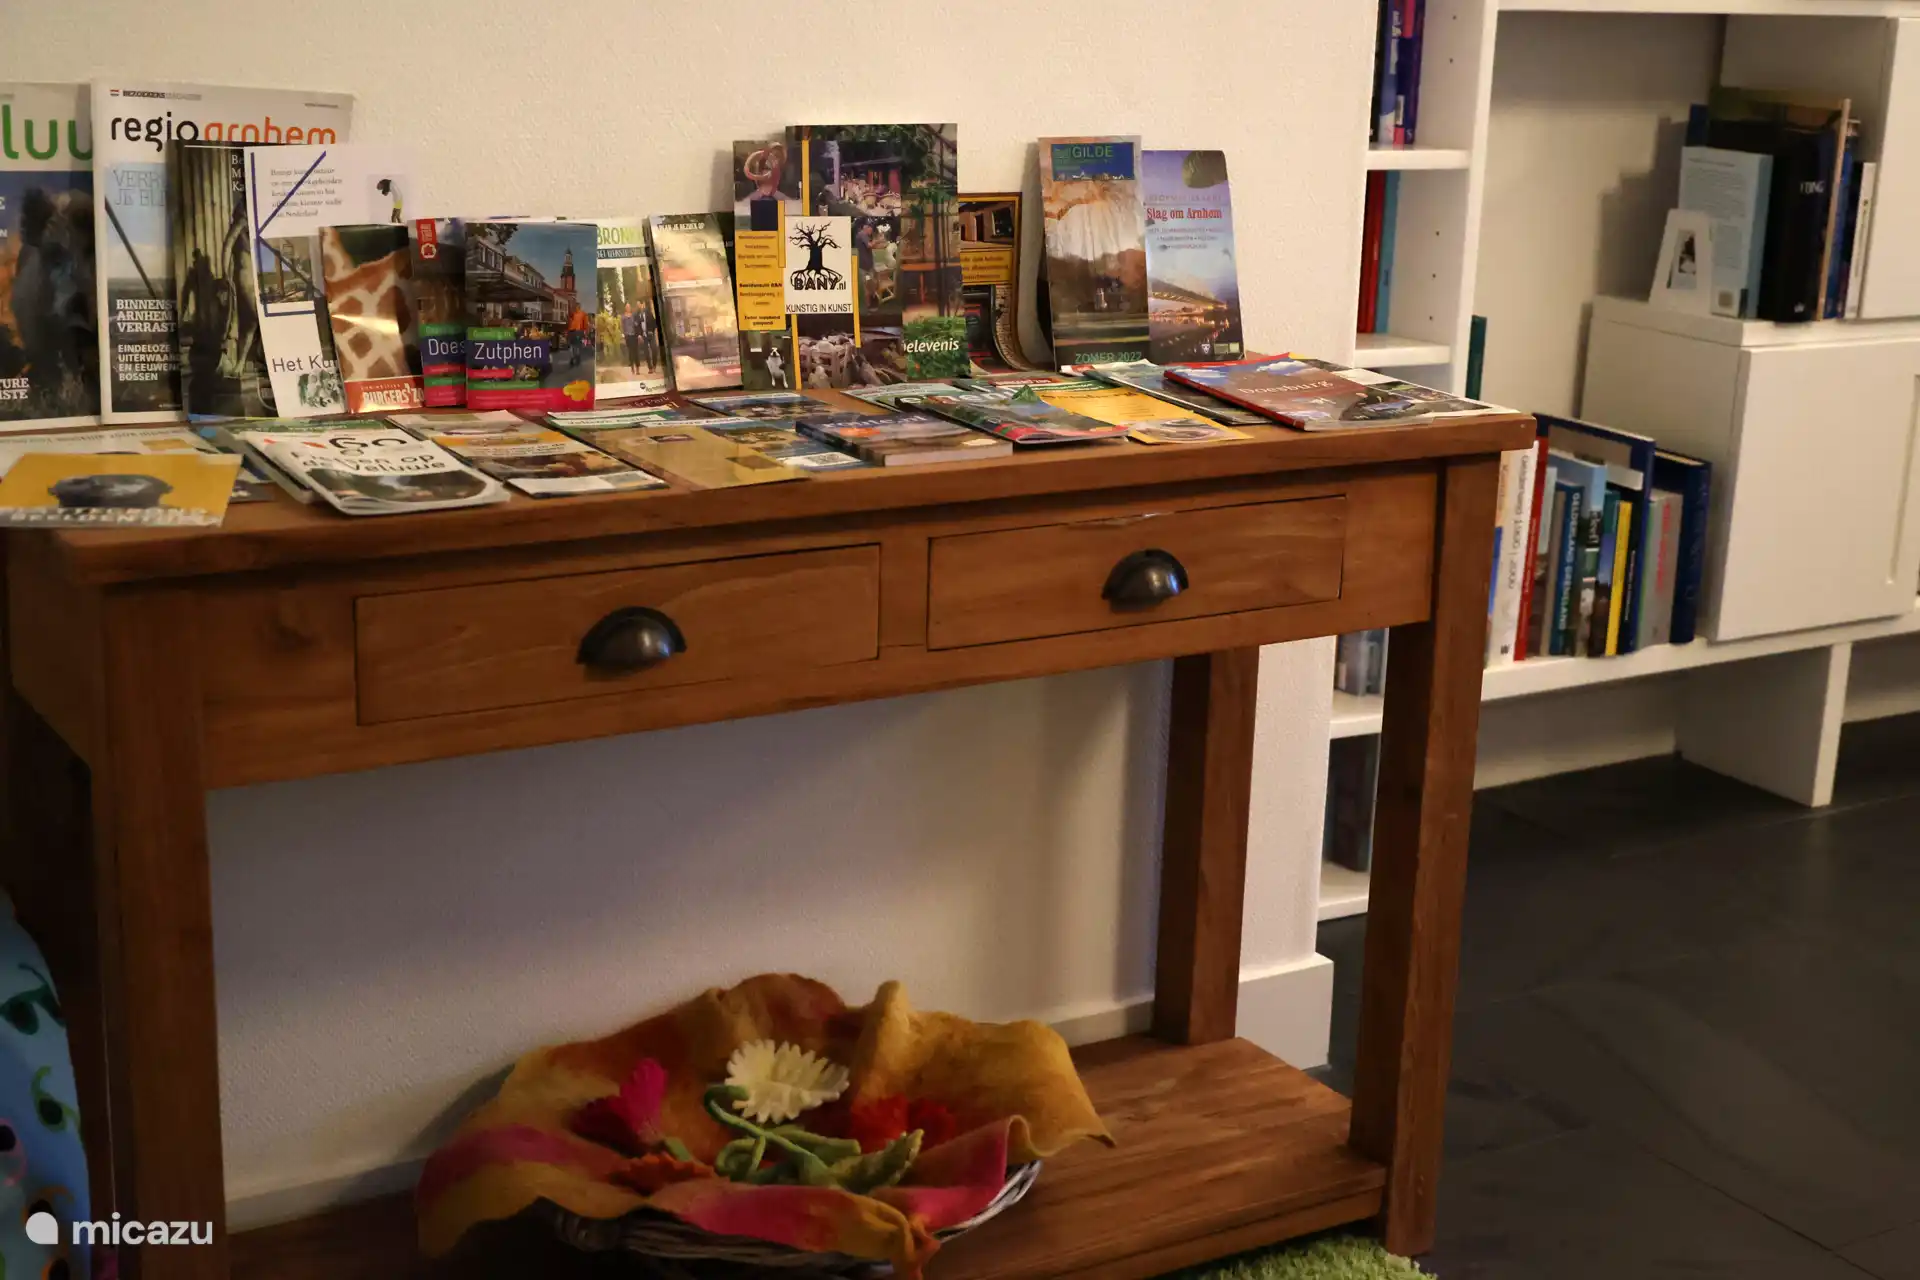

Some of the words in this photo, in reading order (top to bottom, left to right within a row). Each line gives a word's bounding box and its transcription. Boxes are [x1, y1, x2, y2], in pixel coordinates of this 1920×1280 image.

[1072, 145, 1114, 158] GILDE
[1146, 207, 1168, 222] Slag
[1170, 209, 1184, 219] om
[1187, 207, 1222, 219] Arnhem
[786, 304, 818, 313] KUNSTIG
[819, 304, 827, 313] IN
[828, 303, 852, 312] KUNST
[117, 310, 172, 321] ARNHEM
[117, 322, 176, 333] VERRAST
[118, 344, 171, 353] EINDELOZE
[474, 342, 542, 364] Zutphen
[1075, 352, 1116, 364] ZOMER
[119, 364, 132, 372] EN
[272, 357, 303, 373] Het
[119, 372, 158, 381] BOSSEN
[1237, 380, 1335, 394] Doesburg
[400, 453, 435, 464] op
